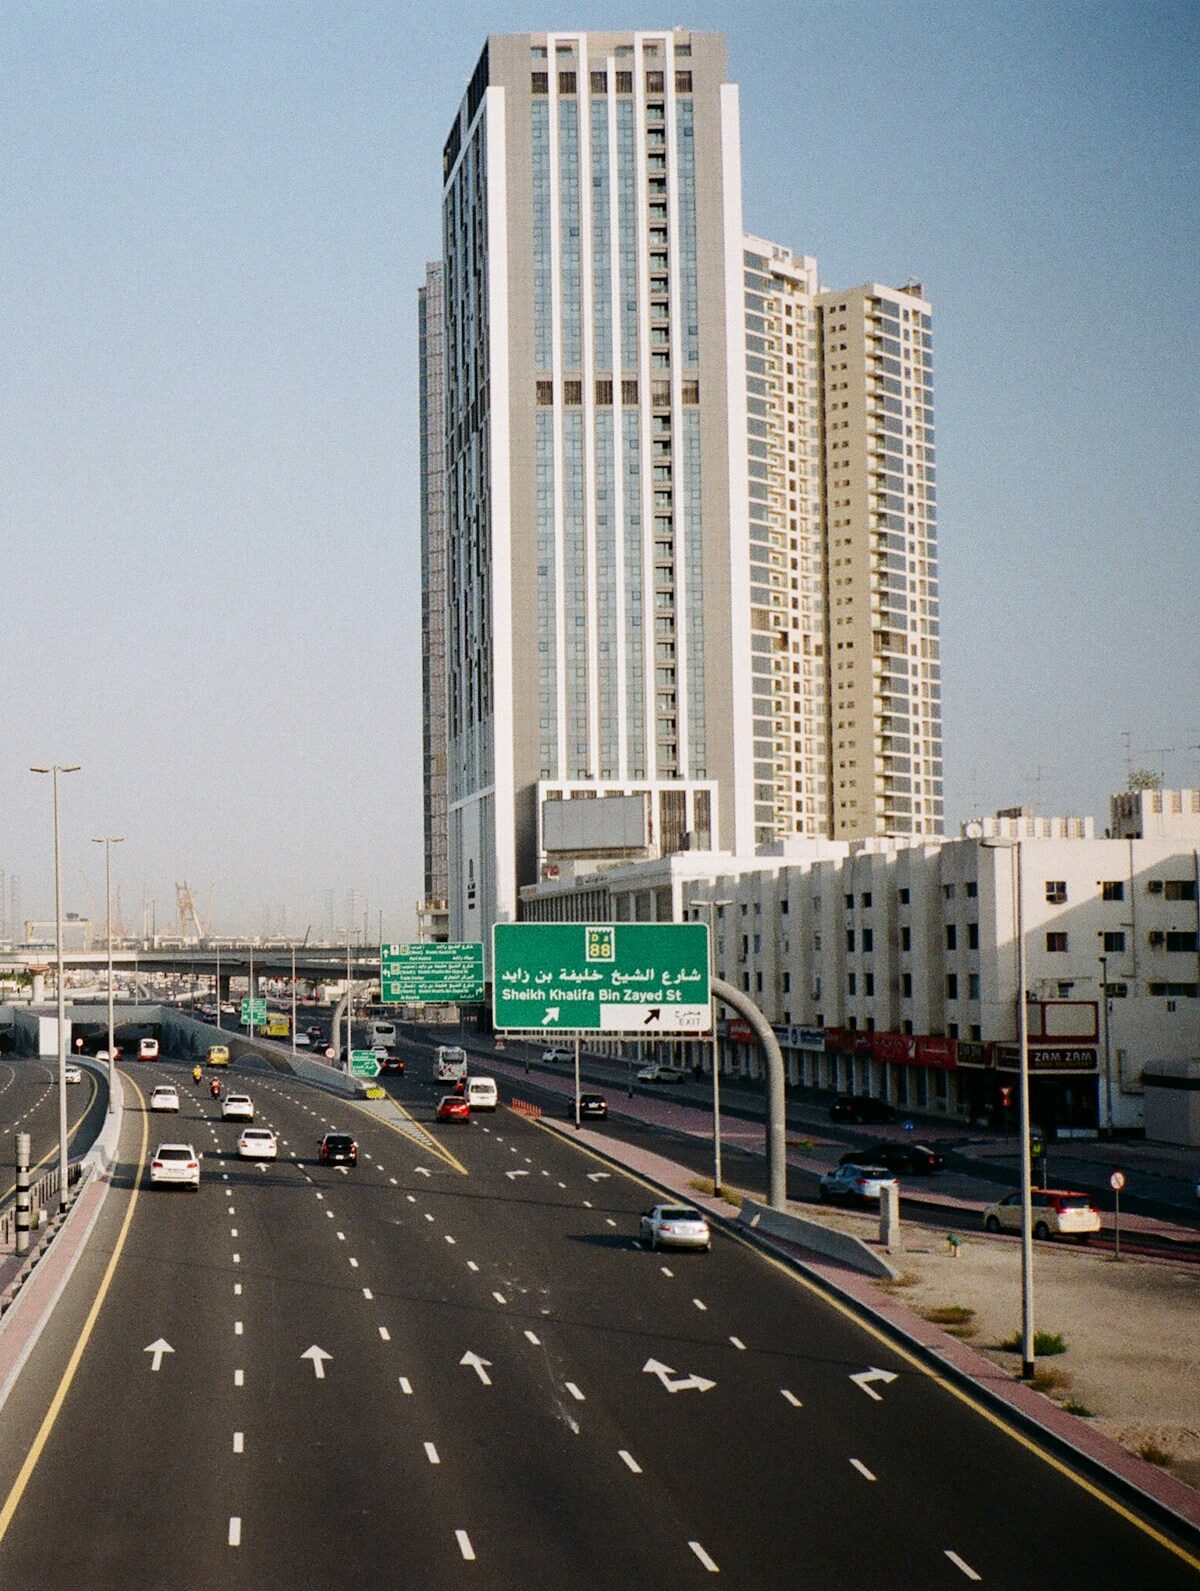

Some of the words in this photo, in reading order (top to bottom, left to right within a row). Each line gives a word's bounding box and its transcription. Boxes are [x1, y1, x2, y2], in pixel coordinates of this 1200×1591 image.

[589, 943, 611, 957] 88
[501, 967, 530, 983] زايد
[534, 970, 553, 984] بن
[558, 968, 604, 983] خليفة
[611, 968, 655, 985] الشيخ
[661, 968, 702, 985] شارع
[502, 988, 546, 1001] Sheikh
[550, 988, 595, 1001] Khalifa
[599, 989, 620, 1001] Bin
[623, 989, 663, 1003] Zayed
[666, 989, 682, 1001] St
[678, 1018, 701, 1026] EXIT
[1034, 1051, 1061, 1062] ZAM
[1064, 1051, 1092, 1062] ZAM
